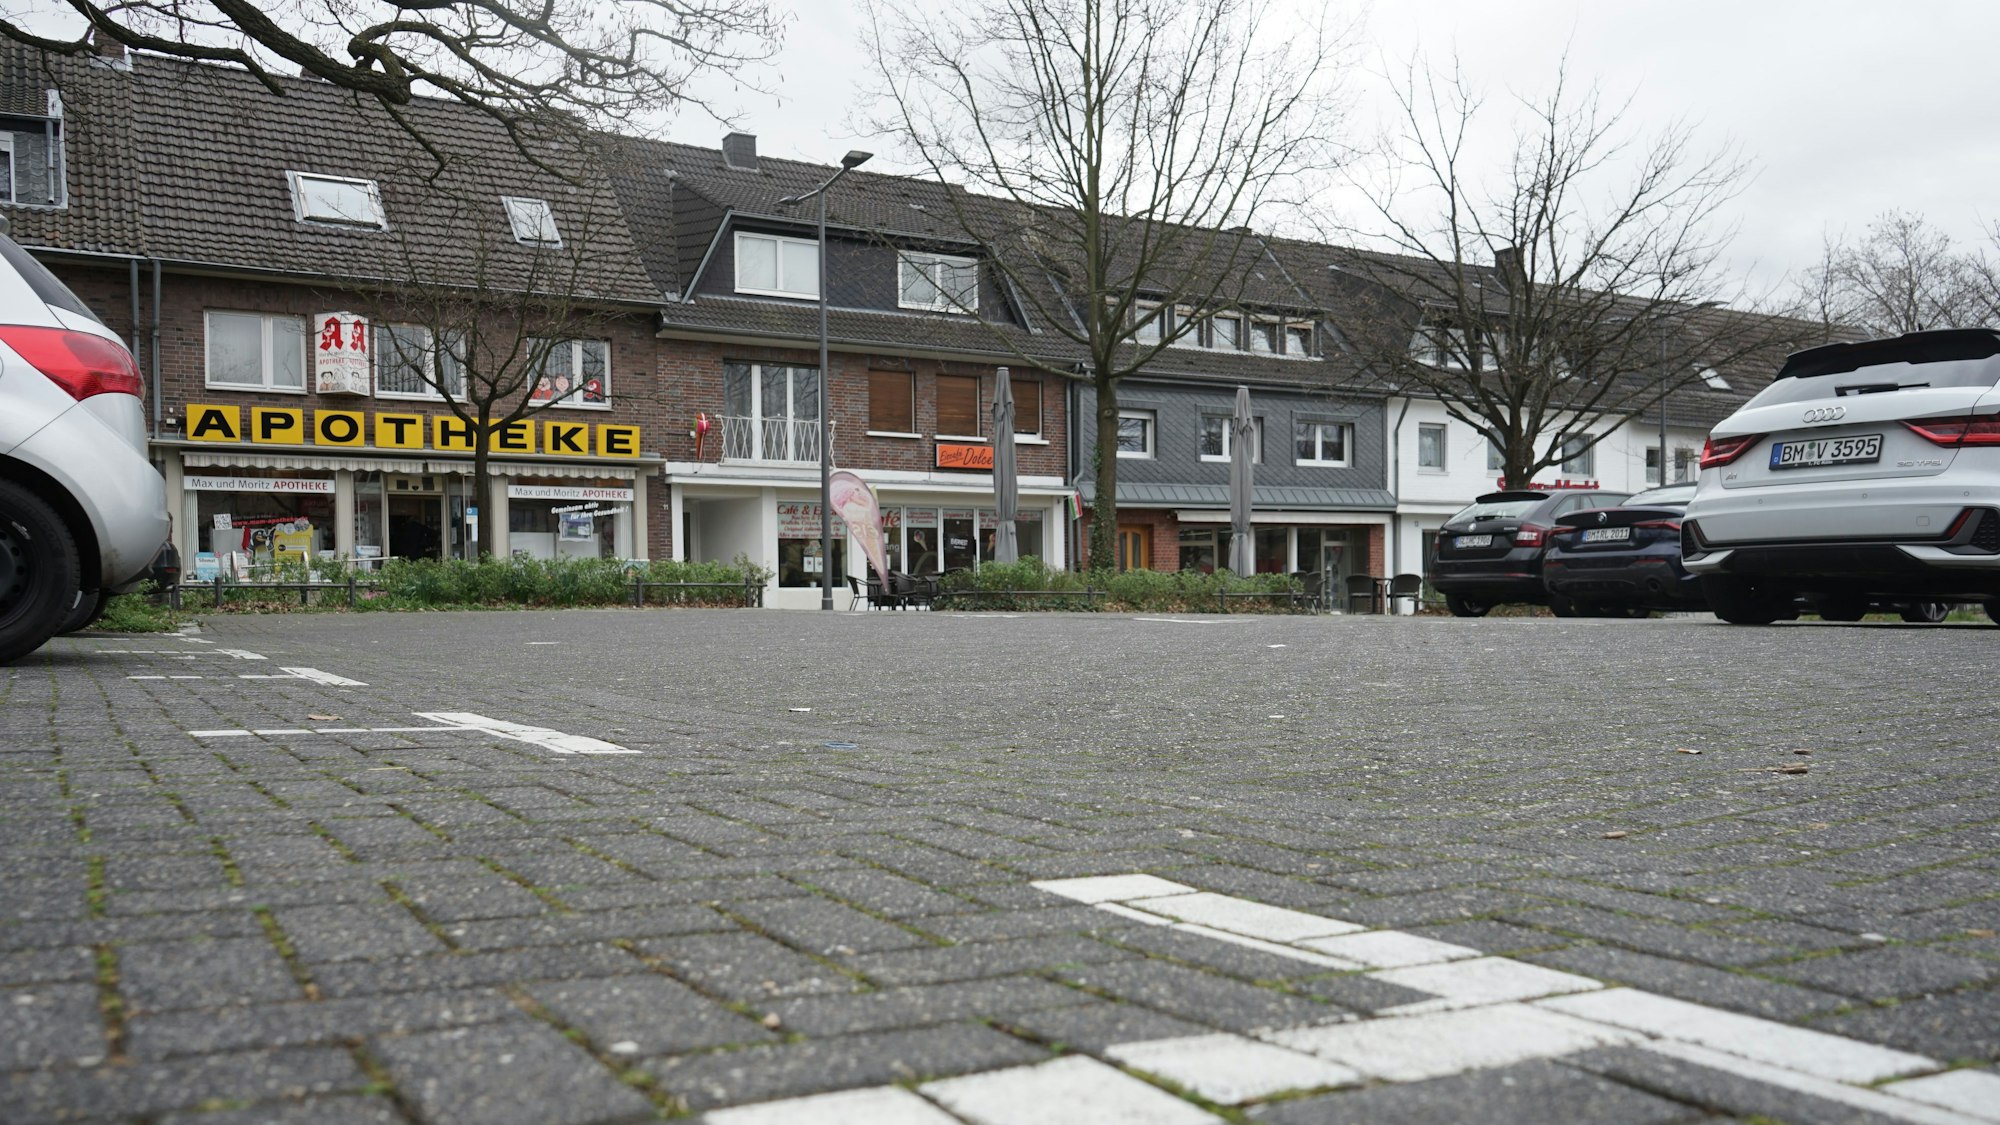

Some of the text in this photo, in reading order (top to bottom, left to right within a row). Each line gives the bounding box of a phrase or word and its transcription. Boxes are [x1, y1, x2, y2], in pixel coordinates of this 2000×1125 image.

[192, 409, 633, 454] APOTHEKE
[1782, 438, 1879, 462] BM V 3595
[963, 447, 993, 466] Dolce
[191, 479, 328, 491] Max und Moritz APOTHEKE
[514, 487, 628, 499] Max und Moritz APOTHEKE
[777, 504, 799, 515] Café
[801, 504, 810, 515] &
[1610, 528, 1628, 539] 2011
